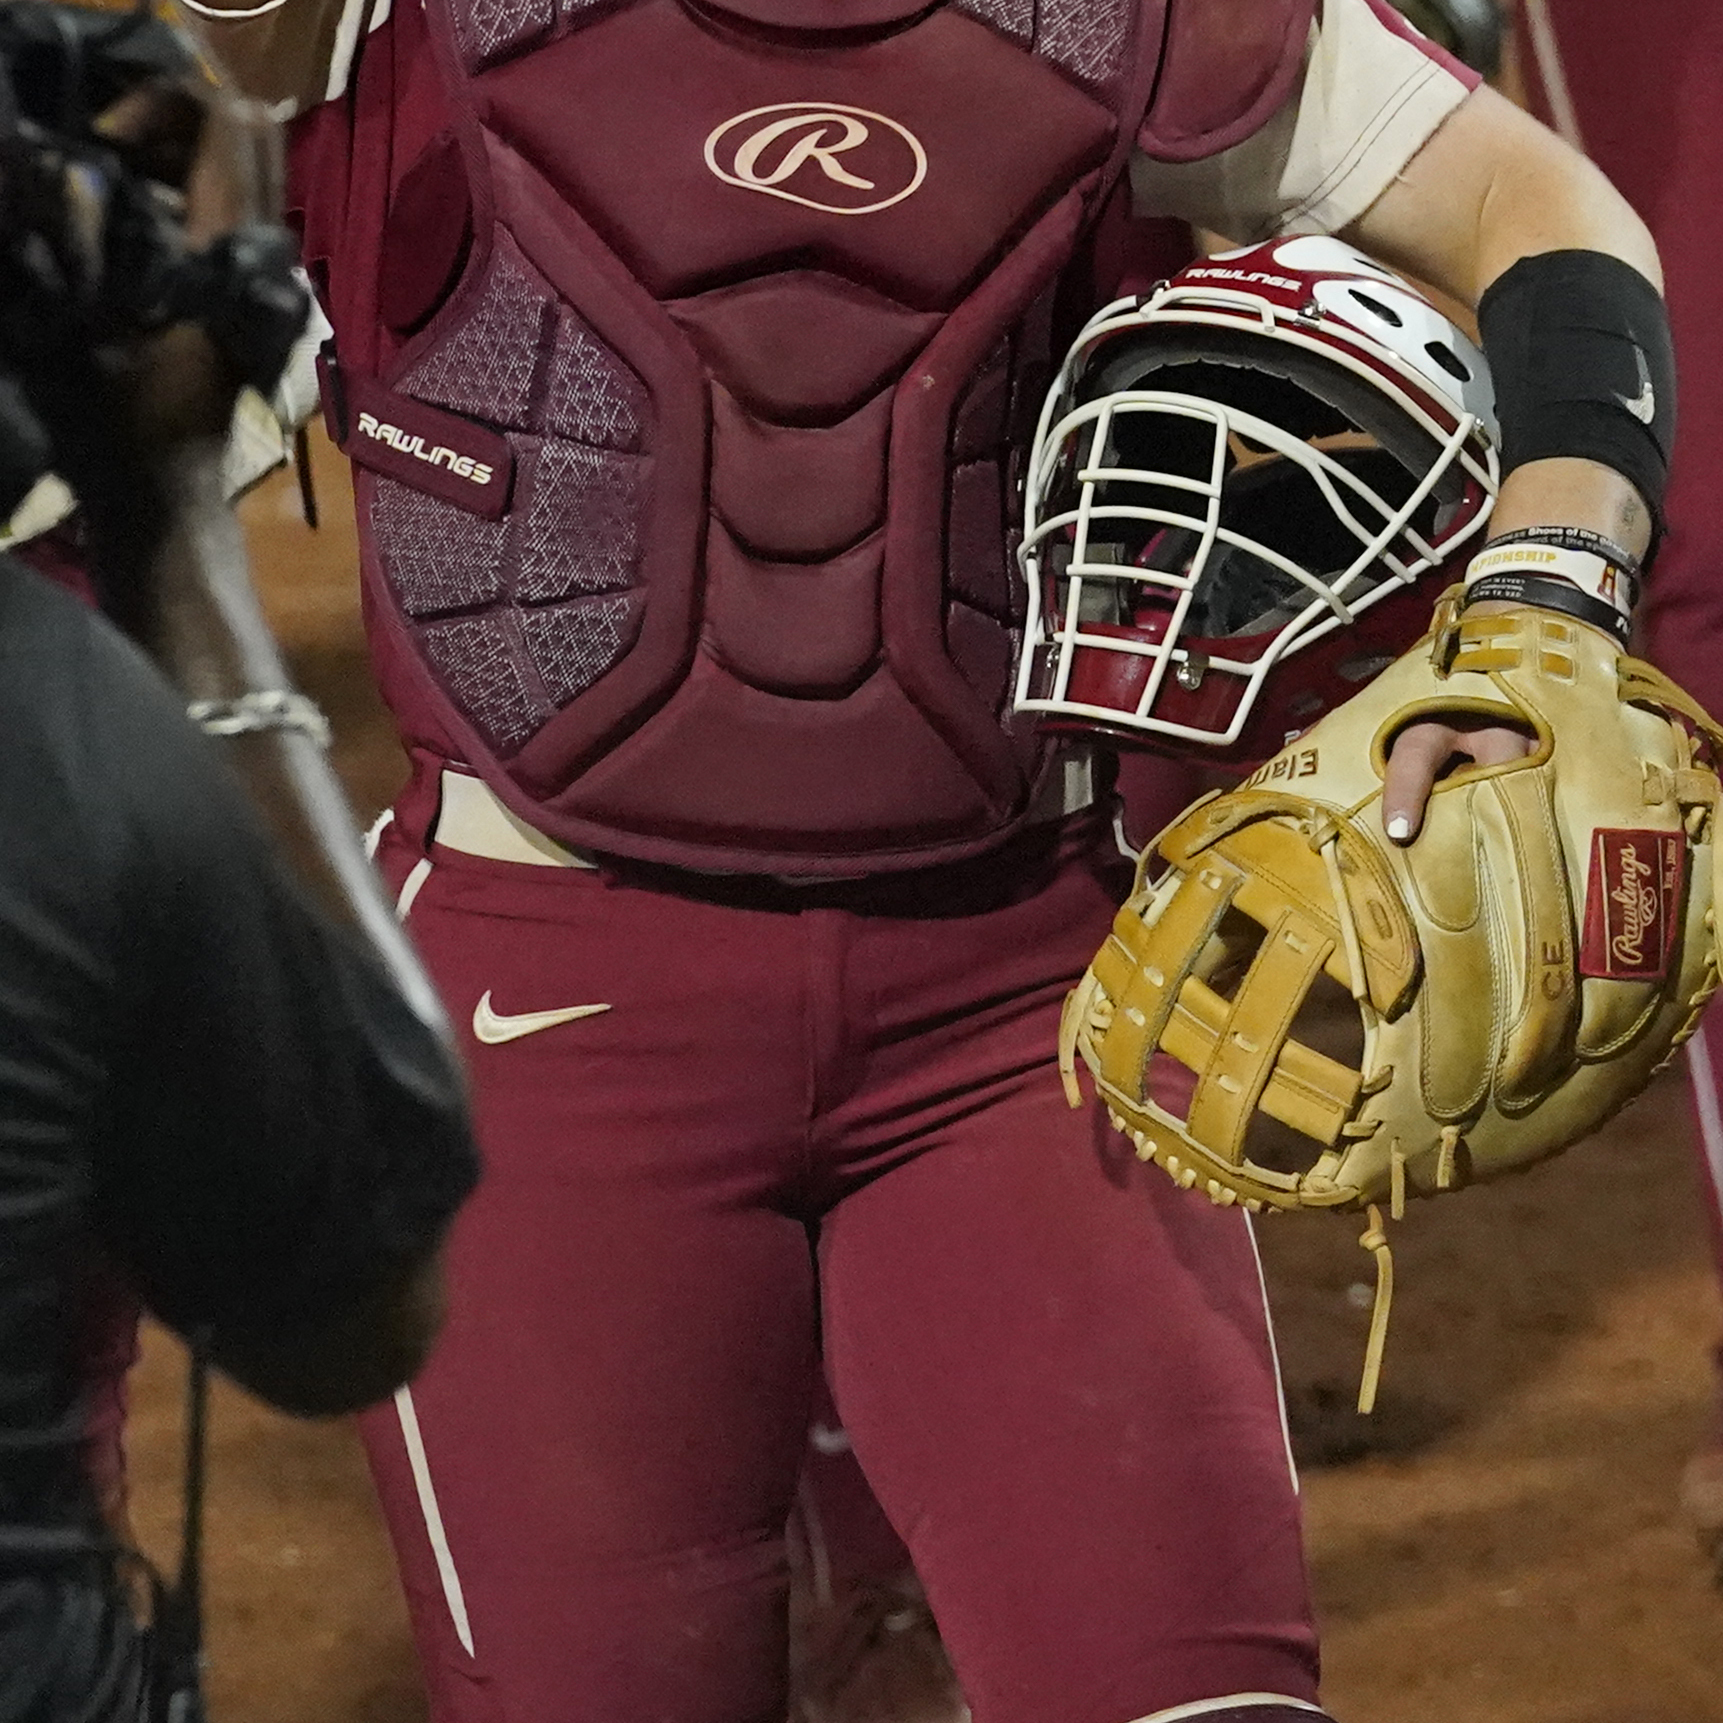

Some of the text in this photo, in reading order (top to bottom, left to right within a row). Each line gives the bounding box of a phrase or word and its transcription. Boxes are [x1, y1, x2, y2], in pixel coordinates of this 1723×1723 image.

[1185, 267, 1302, 292] RAWLINGS
[358, 411, 494, 485] RAWLINGS
[1611, 842, 1651, 966] Rawlings
